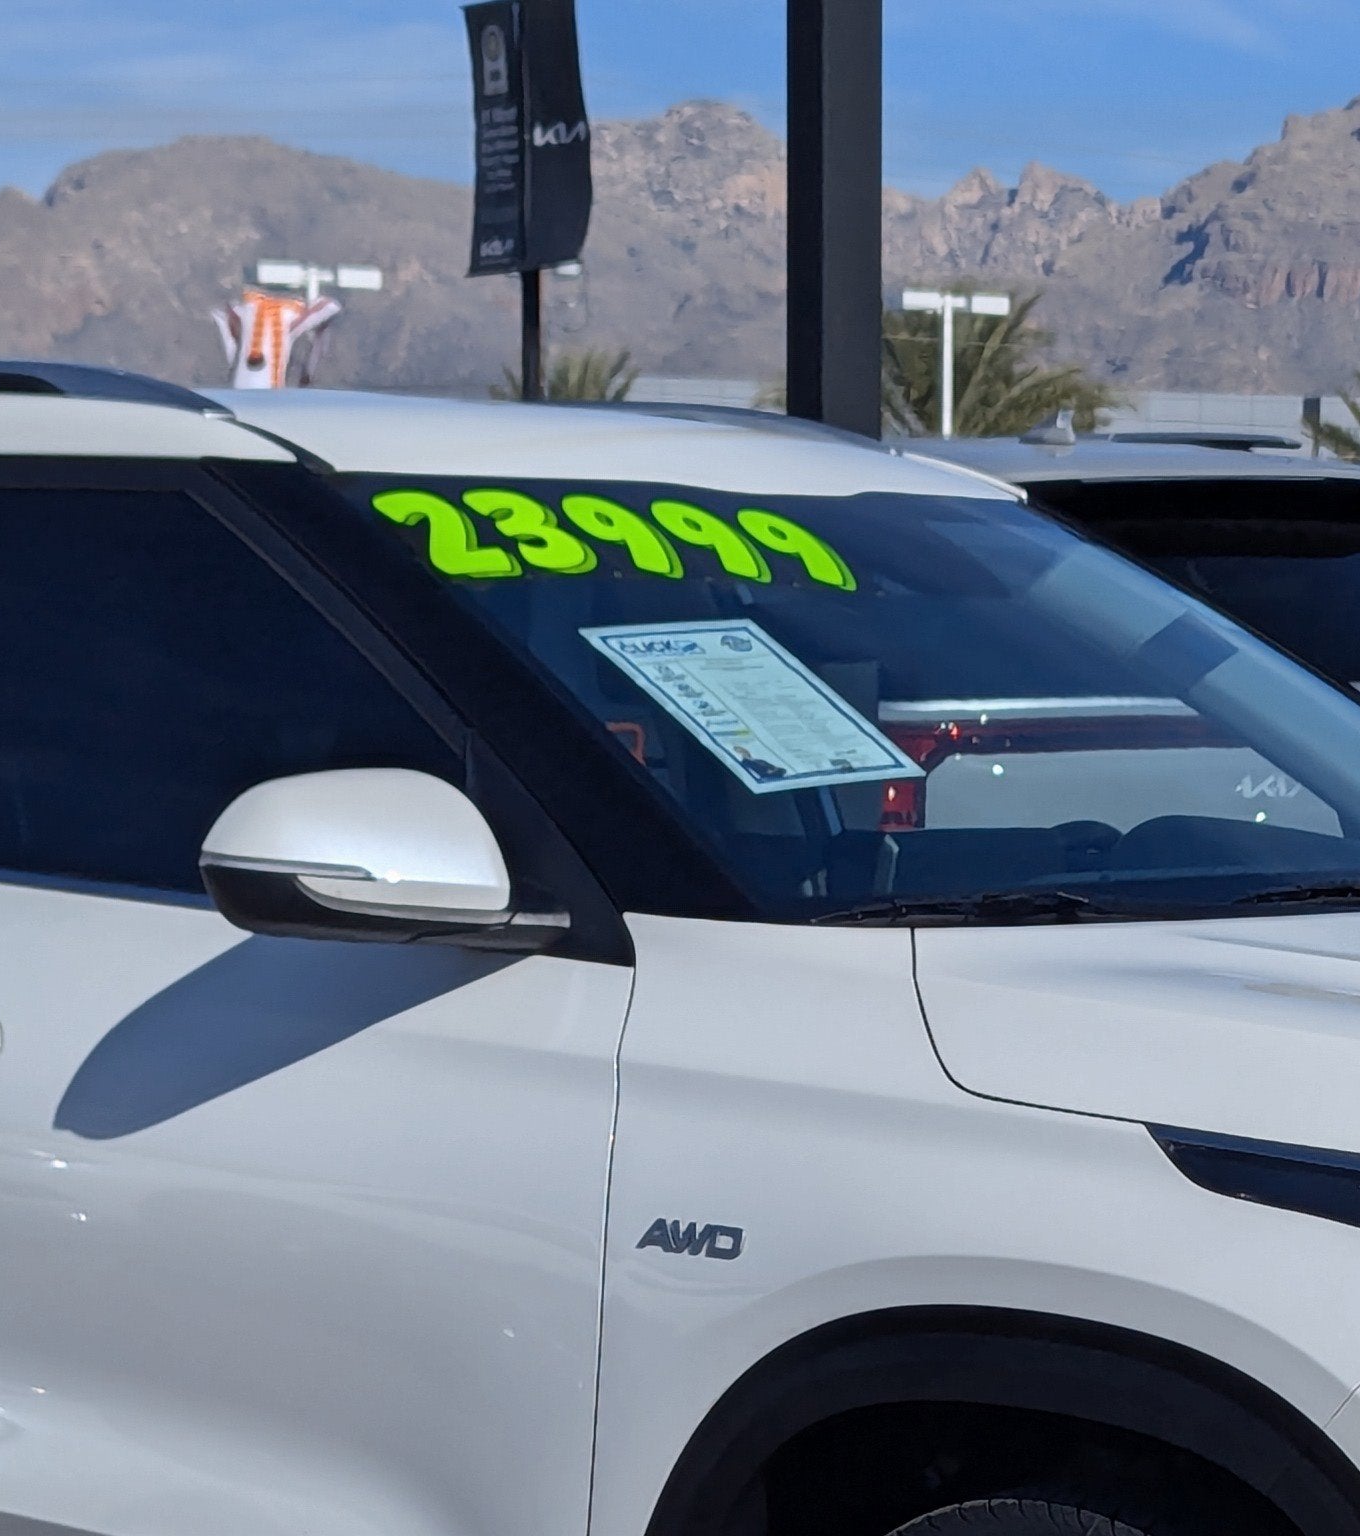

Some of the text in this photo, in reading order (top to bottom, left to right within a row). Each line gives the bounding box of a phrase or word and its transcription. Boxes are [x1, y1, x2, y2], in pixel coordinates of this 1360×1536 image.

[533, 121, 586, 147] KIA
[372, 488, 857, 591] 23999
[635, 1211, 744, 1260] AWD
